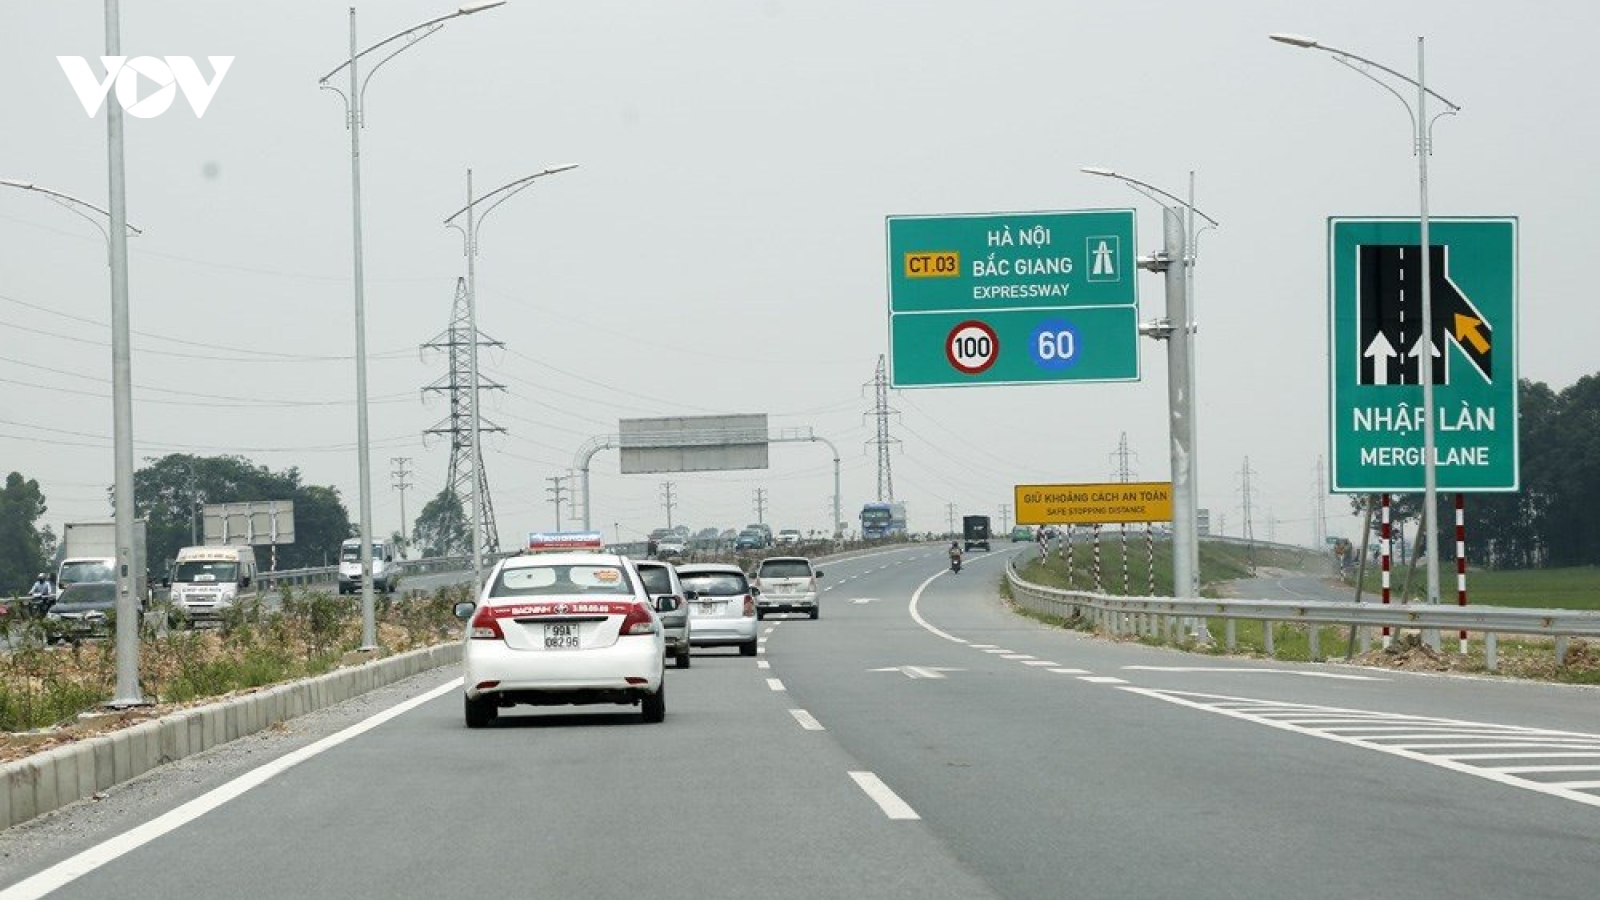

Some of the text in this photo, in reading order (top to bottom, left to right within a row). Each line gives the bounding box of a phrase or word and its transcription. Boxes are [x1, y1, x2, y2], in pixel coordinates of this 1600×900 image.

[987, 225, 1051, 249] HÀ NỘI
[909, 255, 956, 273] CT.03
[972, 252, 1073, 277] BẮC GIANG
[973, 283, 1070, 299] EXPRESSWAY
[955, 337, 990, 358] 100
[1038, 330, 1075, 360] 60
[1439, 400, 1496, 432] LÀN
[1433, 446, 1489, 466] LANE
[1122, 492, 1137, 502] AN
